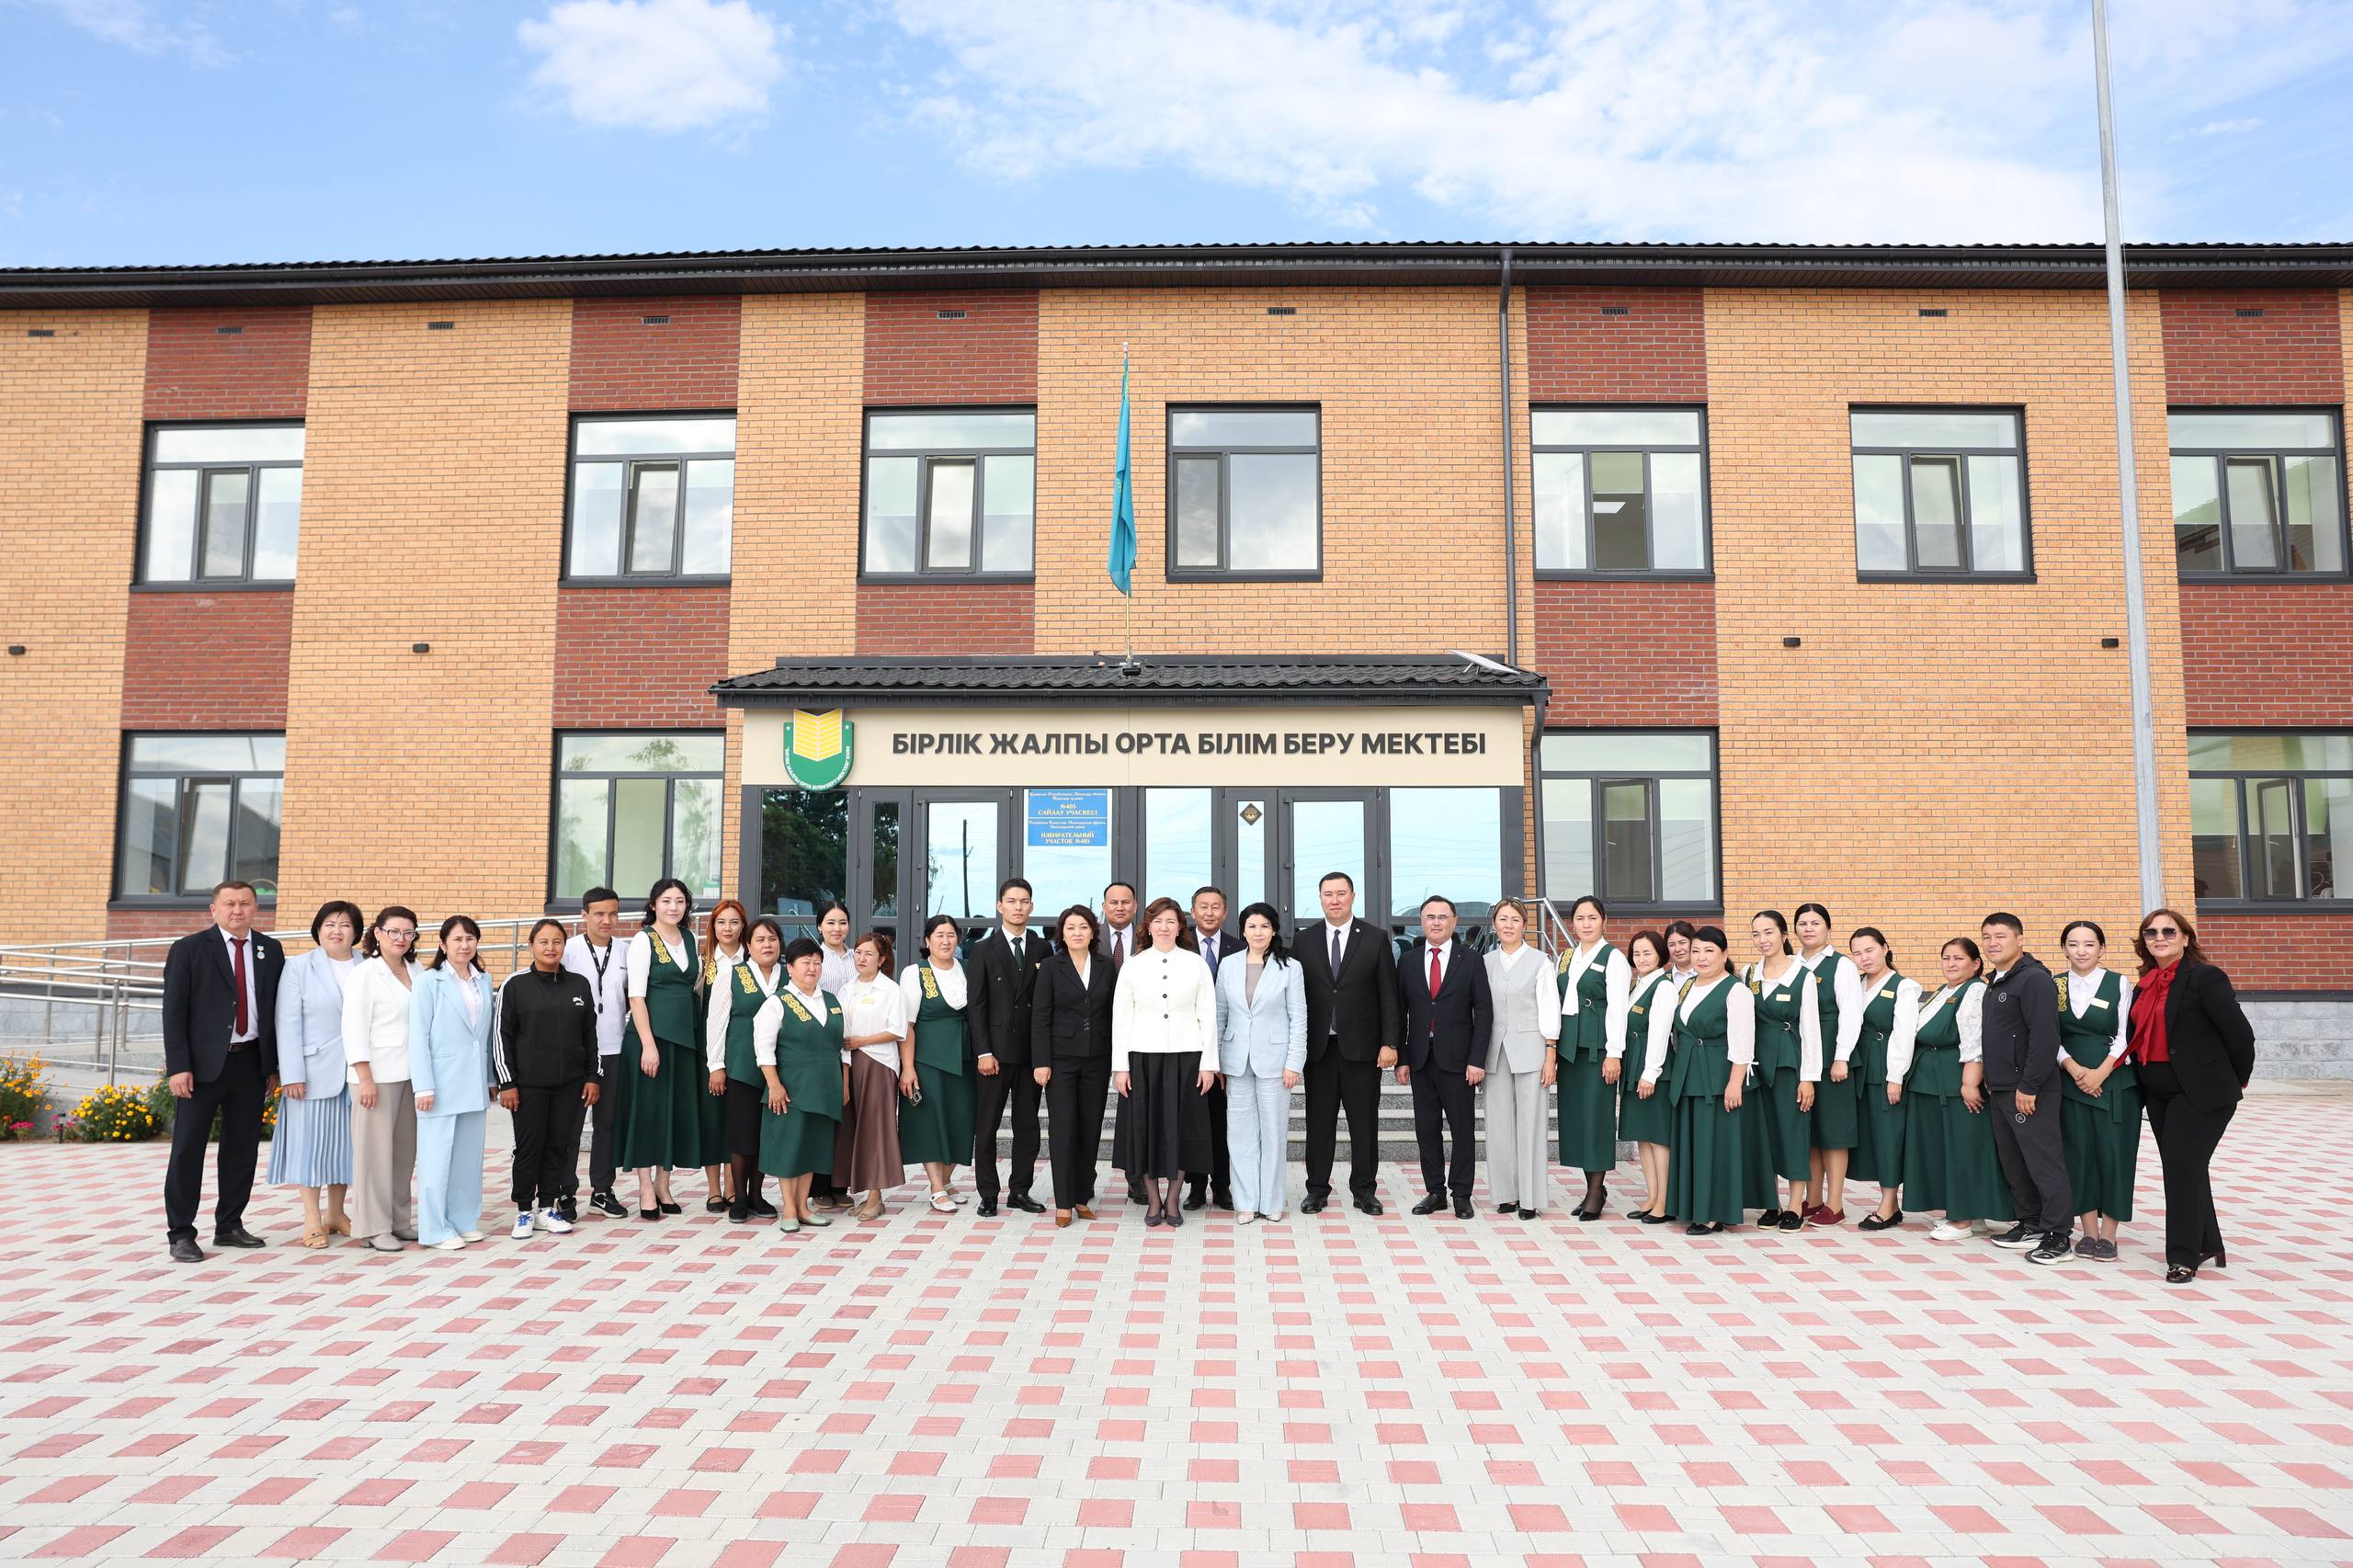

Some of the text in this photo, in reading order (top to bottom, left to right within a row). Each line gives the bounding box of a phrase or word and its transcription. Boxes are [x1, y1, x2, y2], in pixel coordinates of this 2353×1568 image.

[892, 733, 1486, 755] БІРЛІК ЖАЛПЫ ОРТА БІЛІМ БЕРУ МЕКТЕБІ
